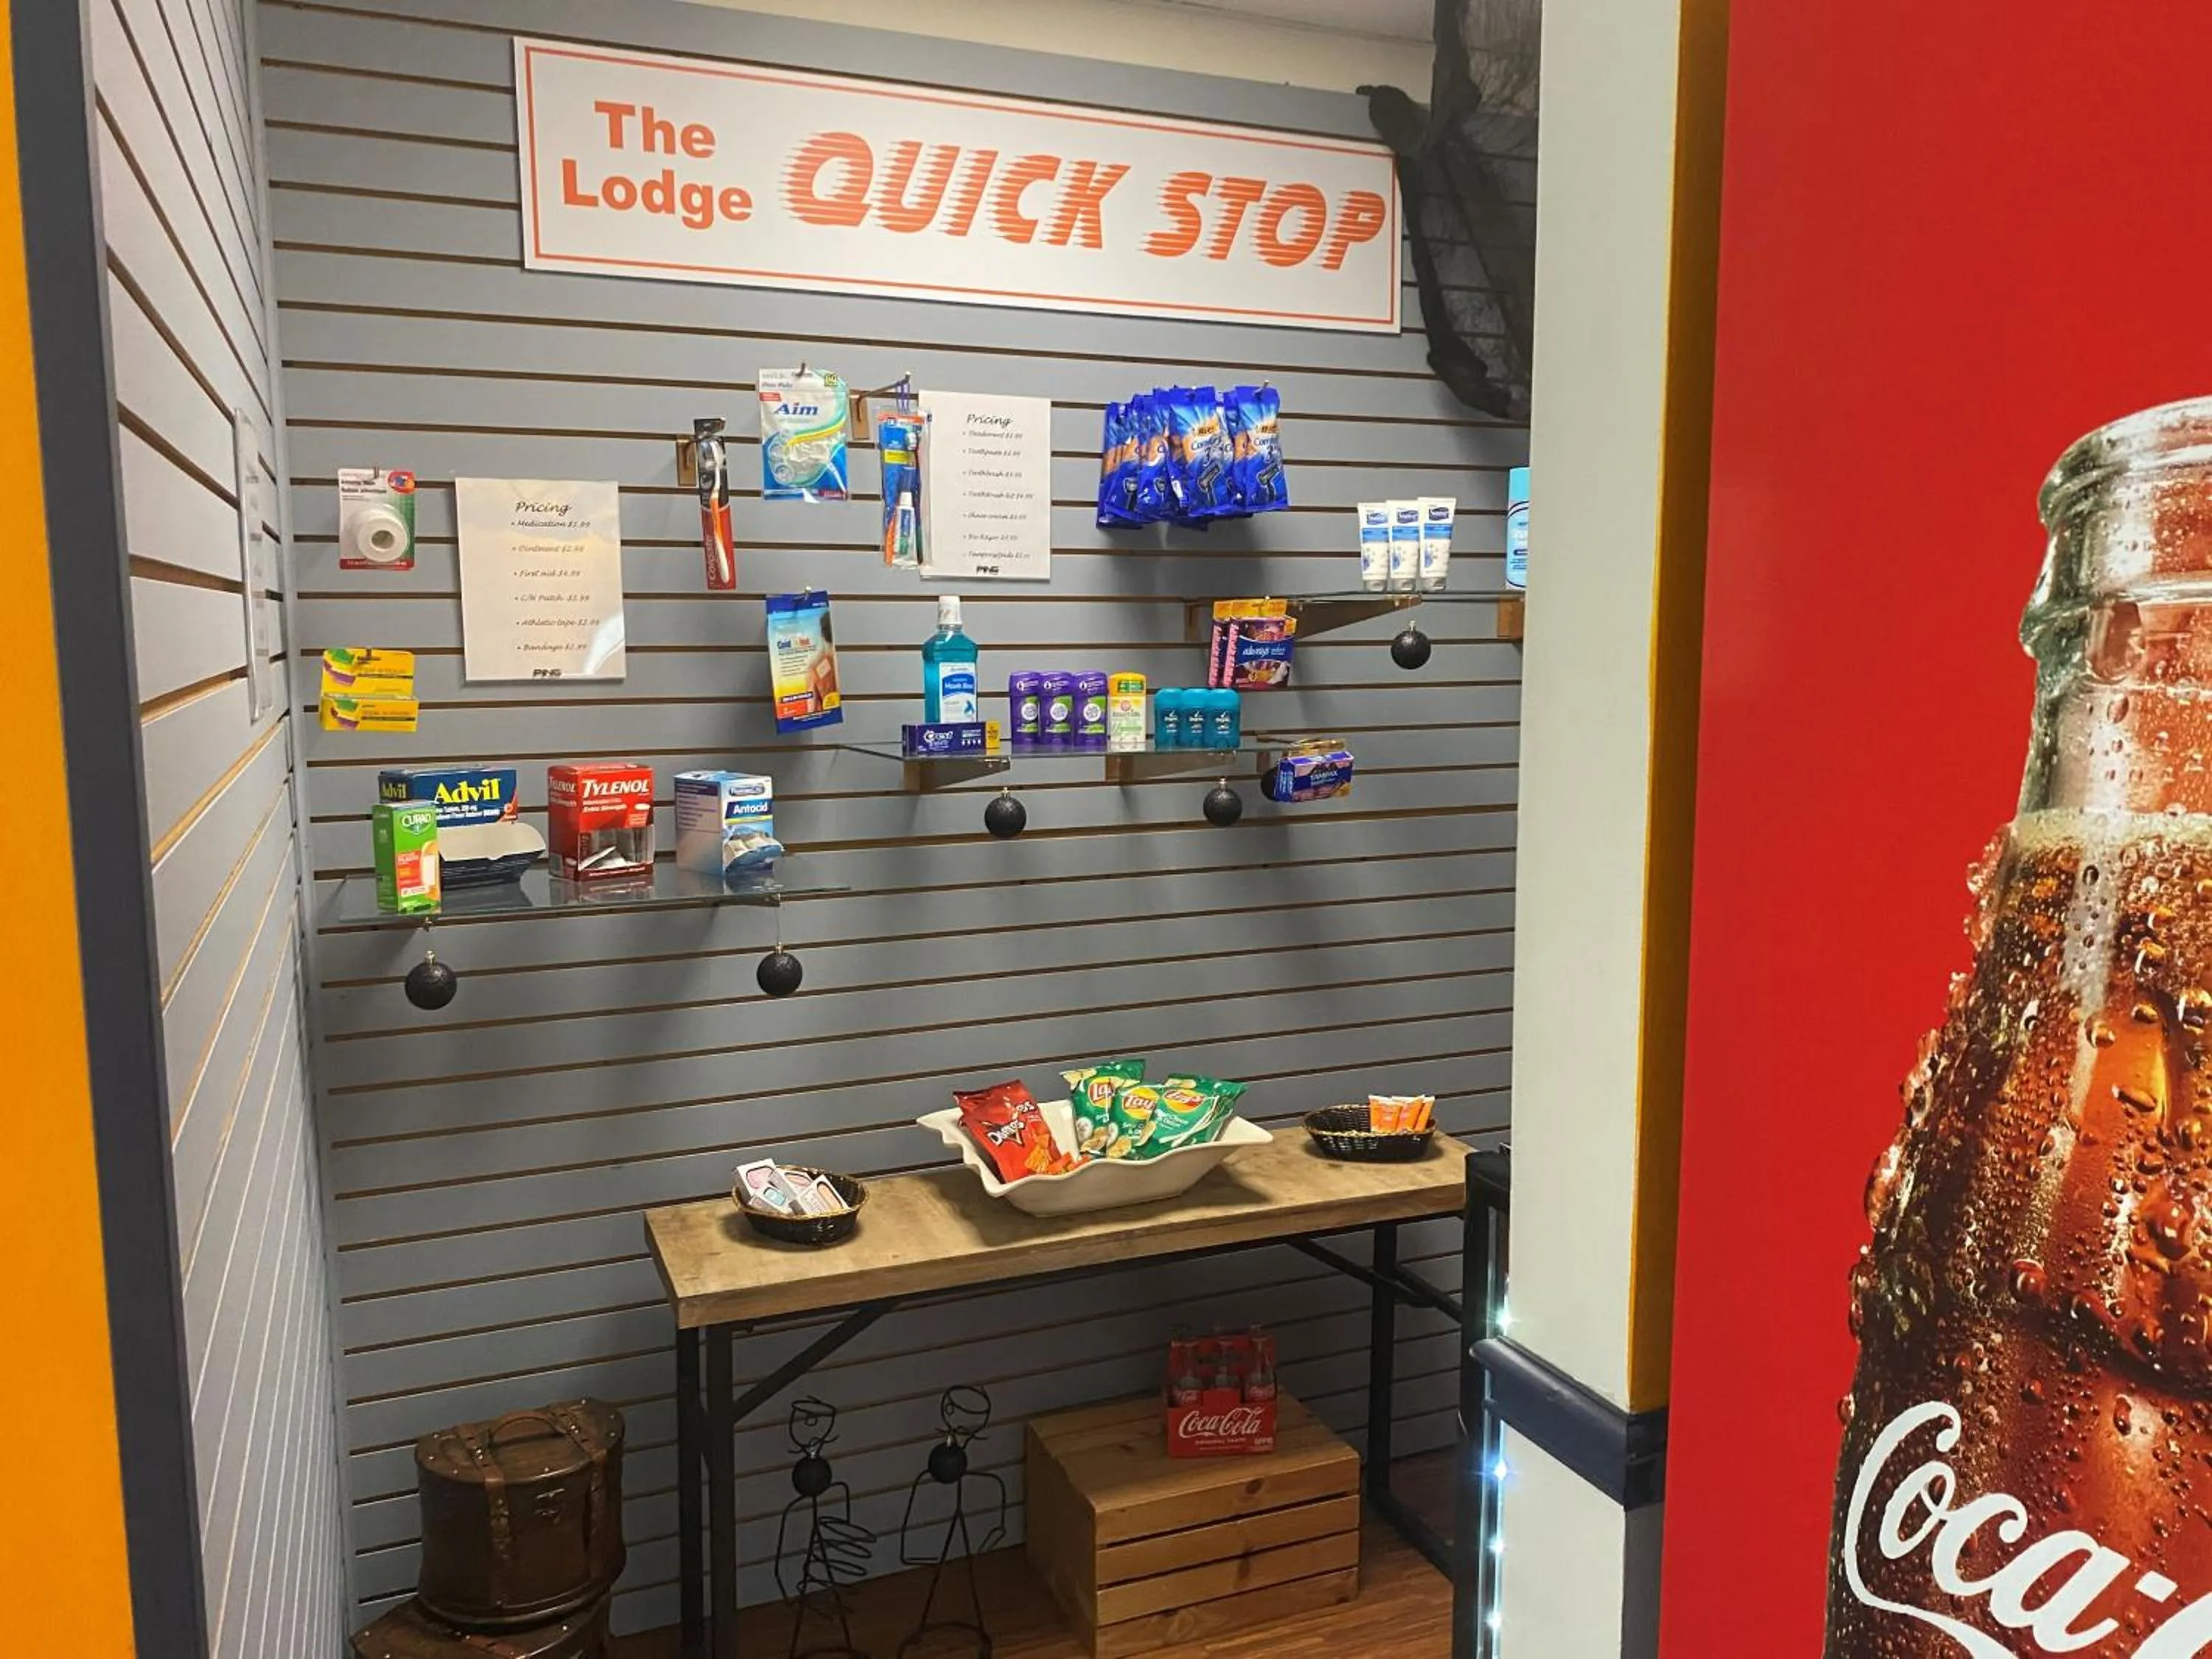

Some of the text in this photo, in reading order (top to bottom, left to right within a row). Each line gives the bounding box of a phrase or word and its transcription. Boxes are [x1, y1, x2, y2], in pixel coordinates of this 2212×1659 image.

[594, 100, 716, 159] The
[561, 158, 753, 229] Lodge
[779, 131, 1387, 271] QUICK STOP
[773, 403, 819, 416] Aim
[967, 414, 1014, 428] Pricing
[515, 501, 572, 517] Pricing
[518, 519, 566, 527] Medication
[532, 668, 563, 678] PING
[381, 782, 407, 799] Advil
[434, 779, 501, 803] Advil
[581, 779, 650, 799] TYLENOL
[733, 801, 768, 815] Antacid
[401, 813, 432, 827] CURAD
[1178, 1406, 1266, 1439] Coca-Cola
